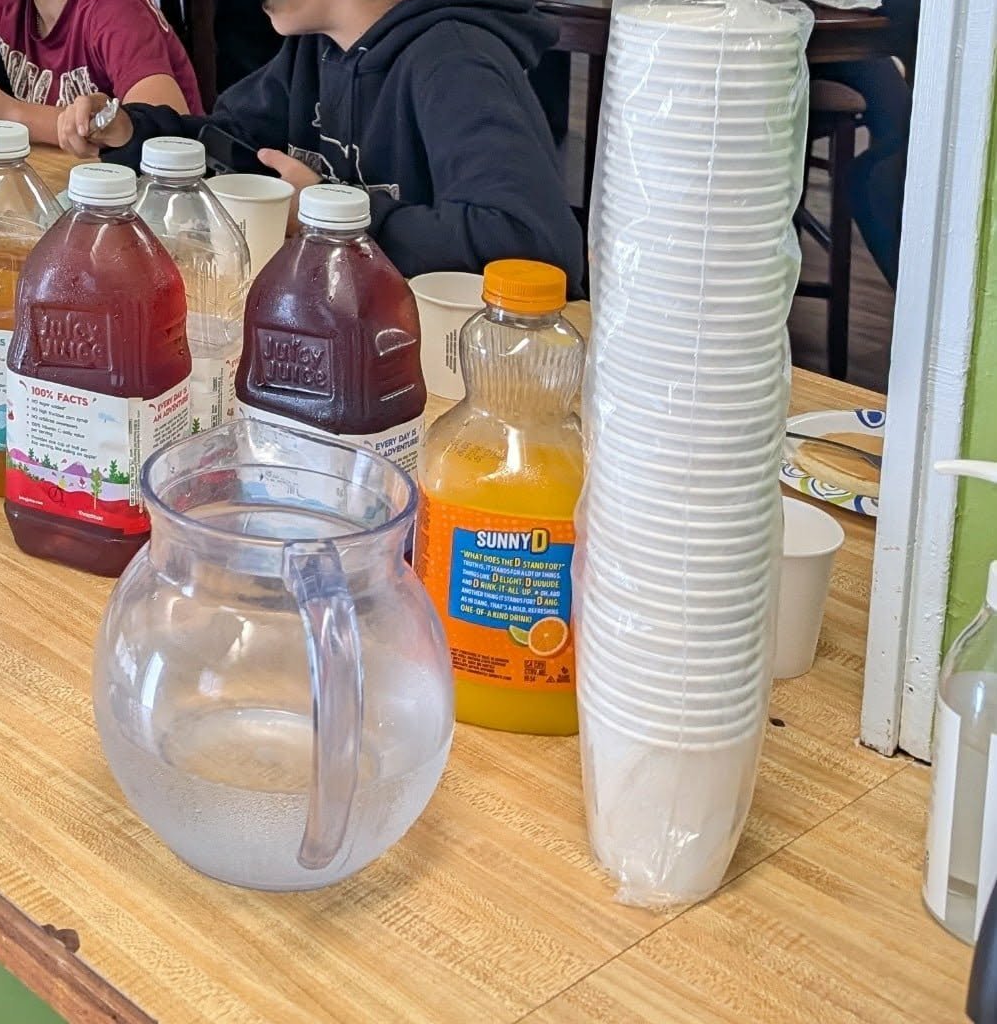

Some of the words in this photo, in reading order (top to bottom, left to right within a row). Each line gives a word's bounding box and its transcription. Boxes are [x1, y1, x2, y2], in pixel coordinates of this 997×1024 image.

[39, 312, 97, 342] Juicy
[263, 334, 325, 370] Juicy
[265, 360, 328, 386] Juice
[31, 386, 53, 399] 100%
[57, 392, 89, 406] FACTS
[375, 436, 397, 450] EVERY
[398, 431, 411, 442] DAY
[411, 428, 417, 437] IS
[476, 528, 549, 553] SUNNYD
[463, 559, 478, 568] TRUTH
[491, 565, 509, 574] STANDS
[483, 554, 501, 565] DOES
[501, 558, 514, 567] THE
[514, 557, 521, 567] D
[522, 561, 545, 570] STAND
[461, 587, 483, 597] ANOTHER
